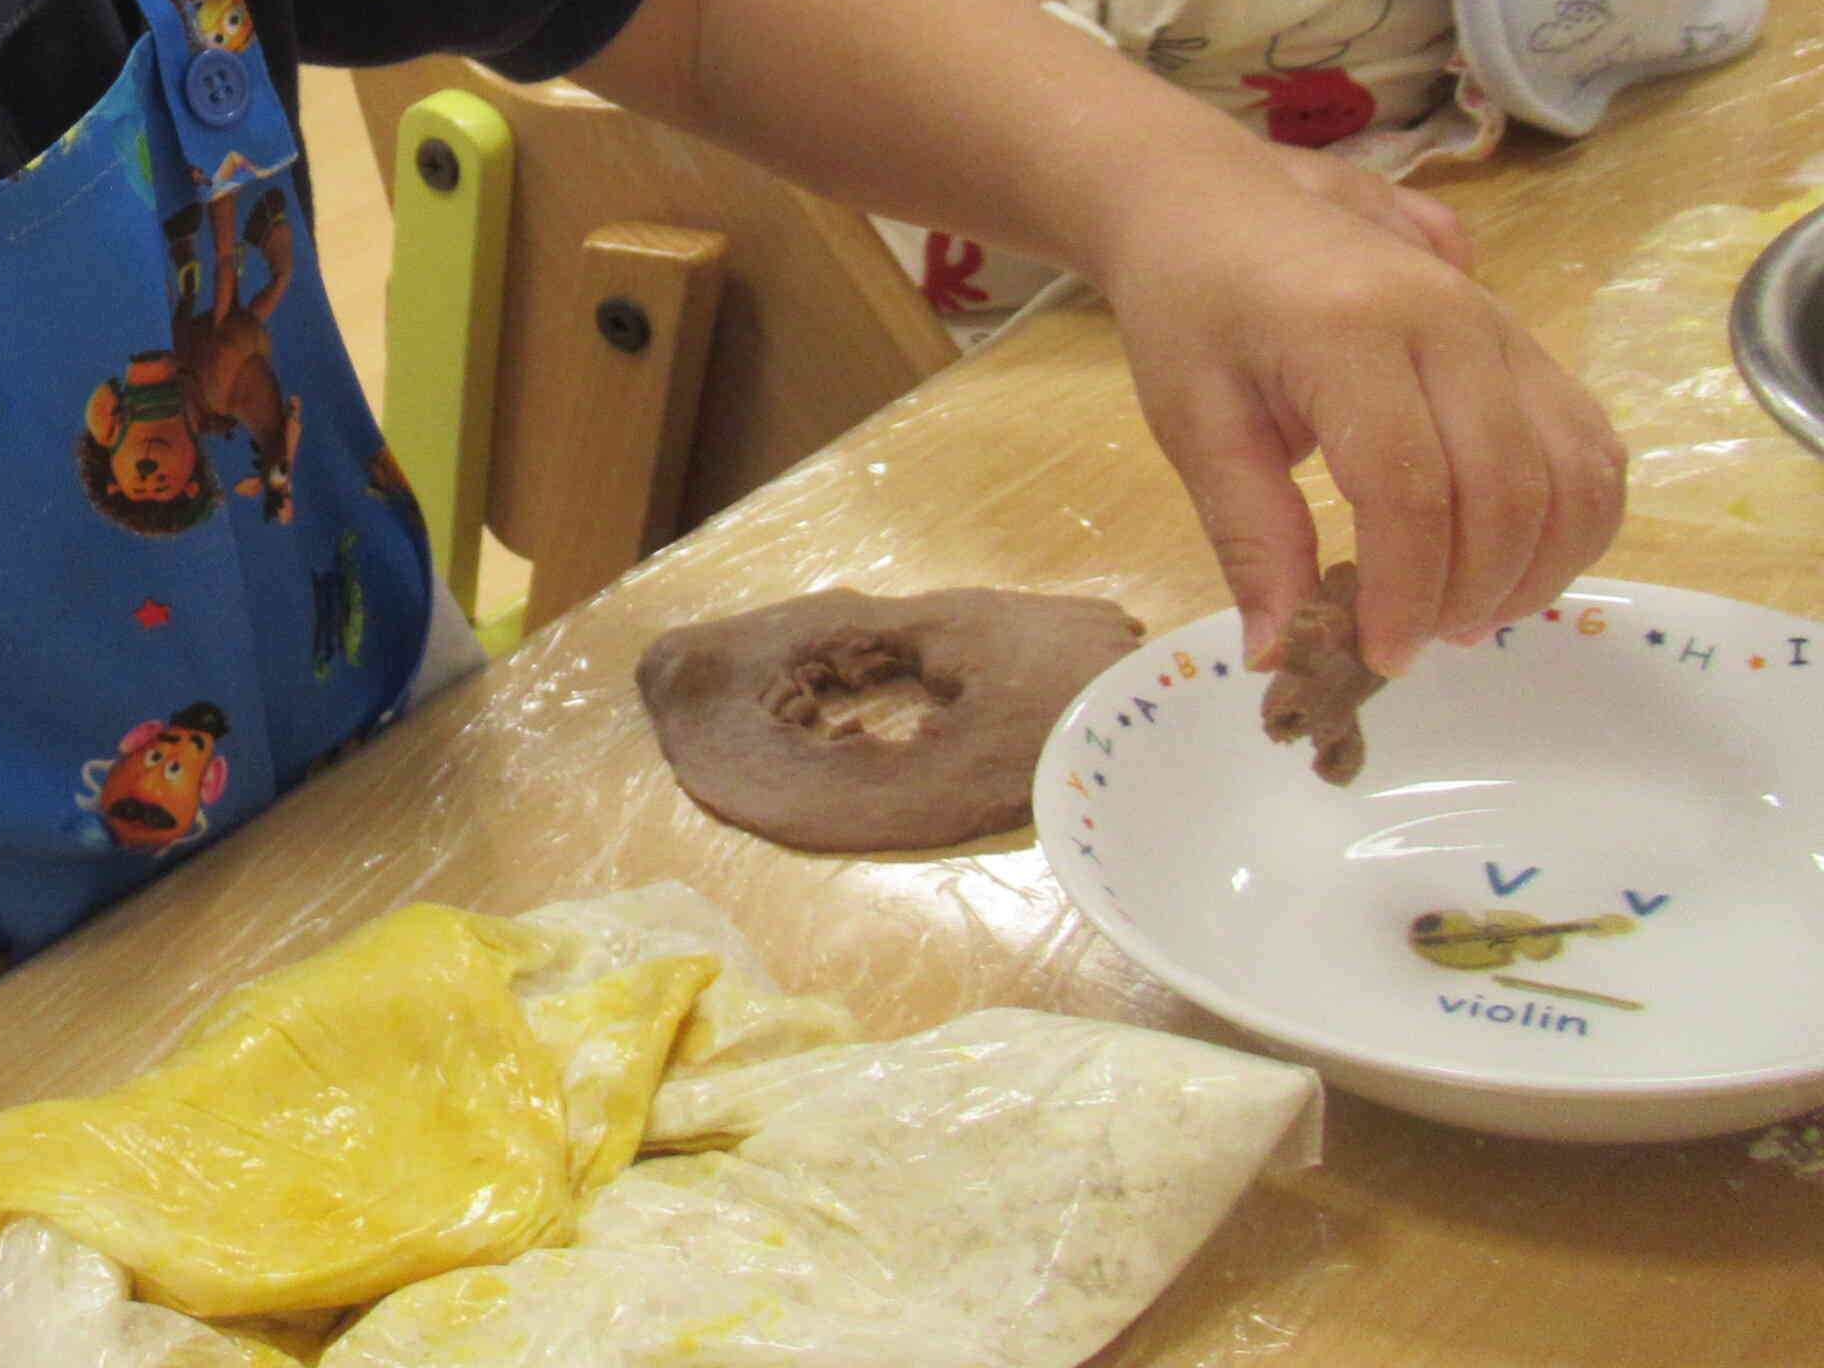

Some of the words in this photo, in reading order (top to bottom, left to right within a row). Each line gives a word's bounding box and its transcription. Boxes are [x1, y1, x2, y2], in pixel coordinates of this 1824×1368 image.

[1084, 727, 1112, 757] Z
[1132, 696, 1159, 724] A
[1172, 650, 1199, 680] B
[1678, 637, 1717, 672] H
[1787, 637, 1809, 667] I
[1438, 993, 1589, 1037] violin
